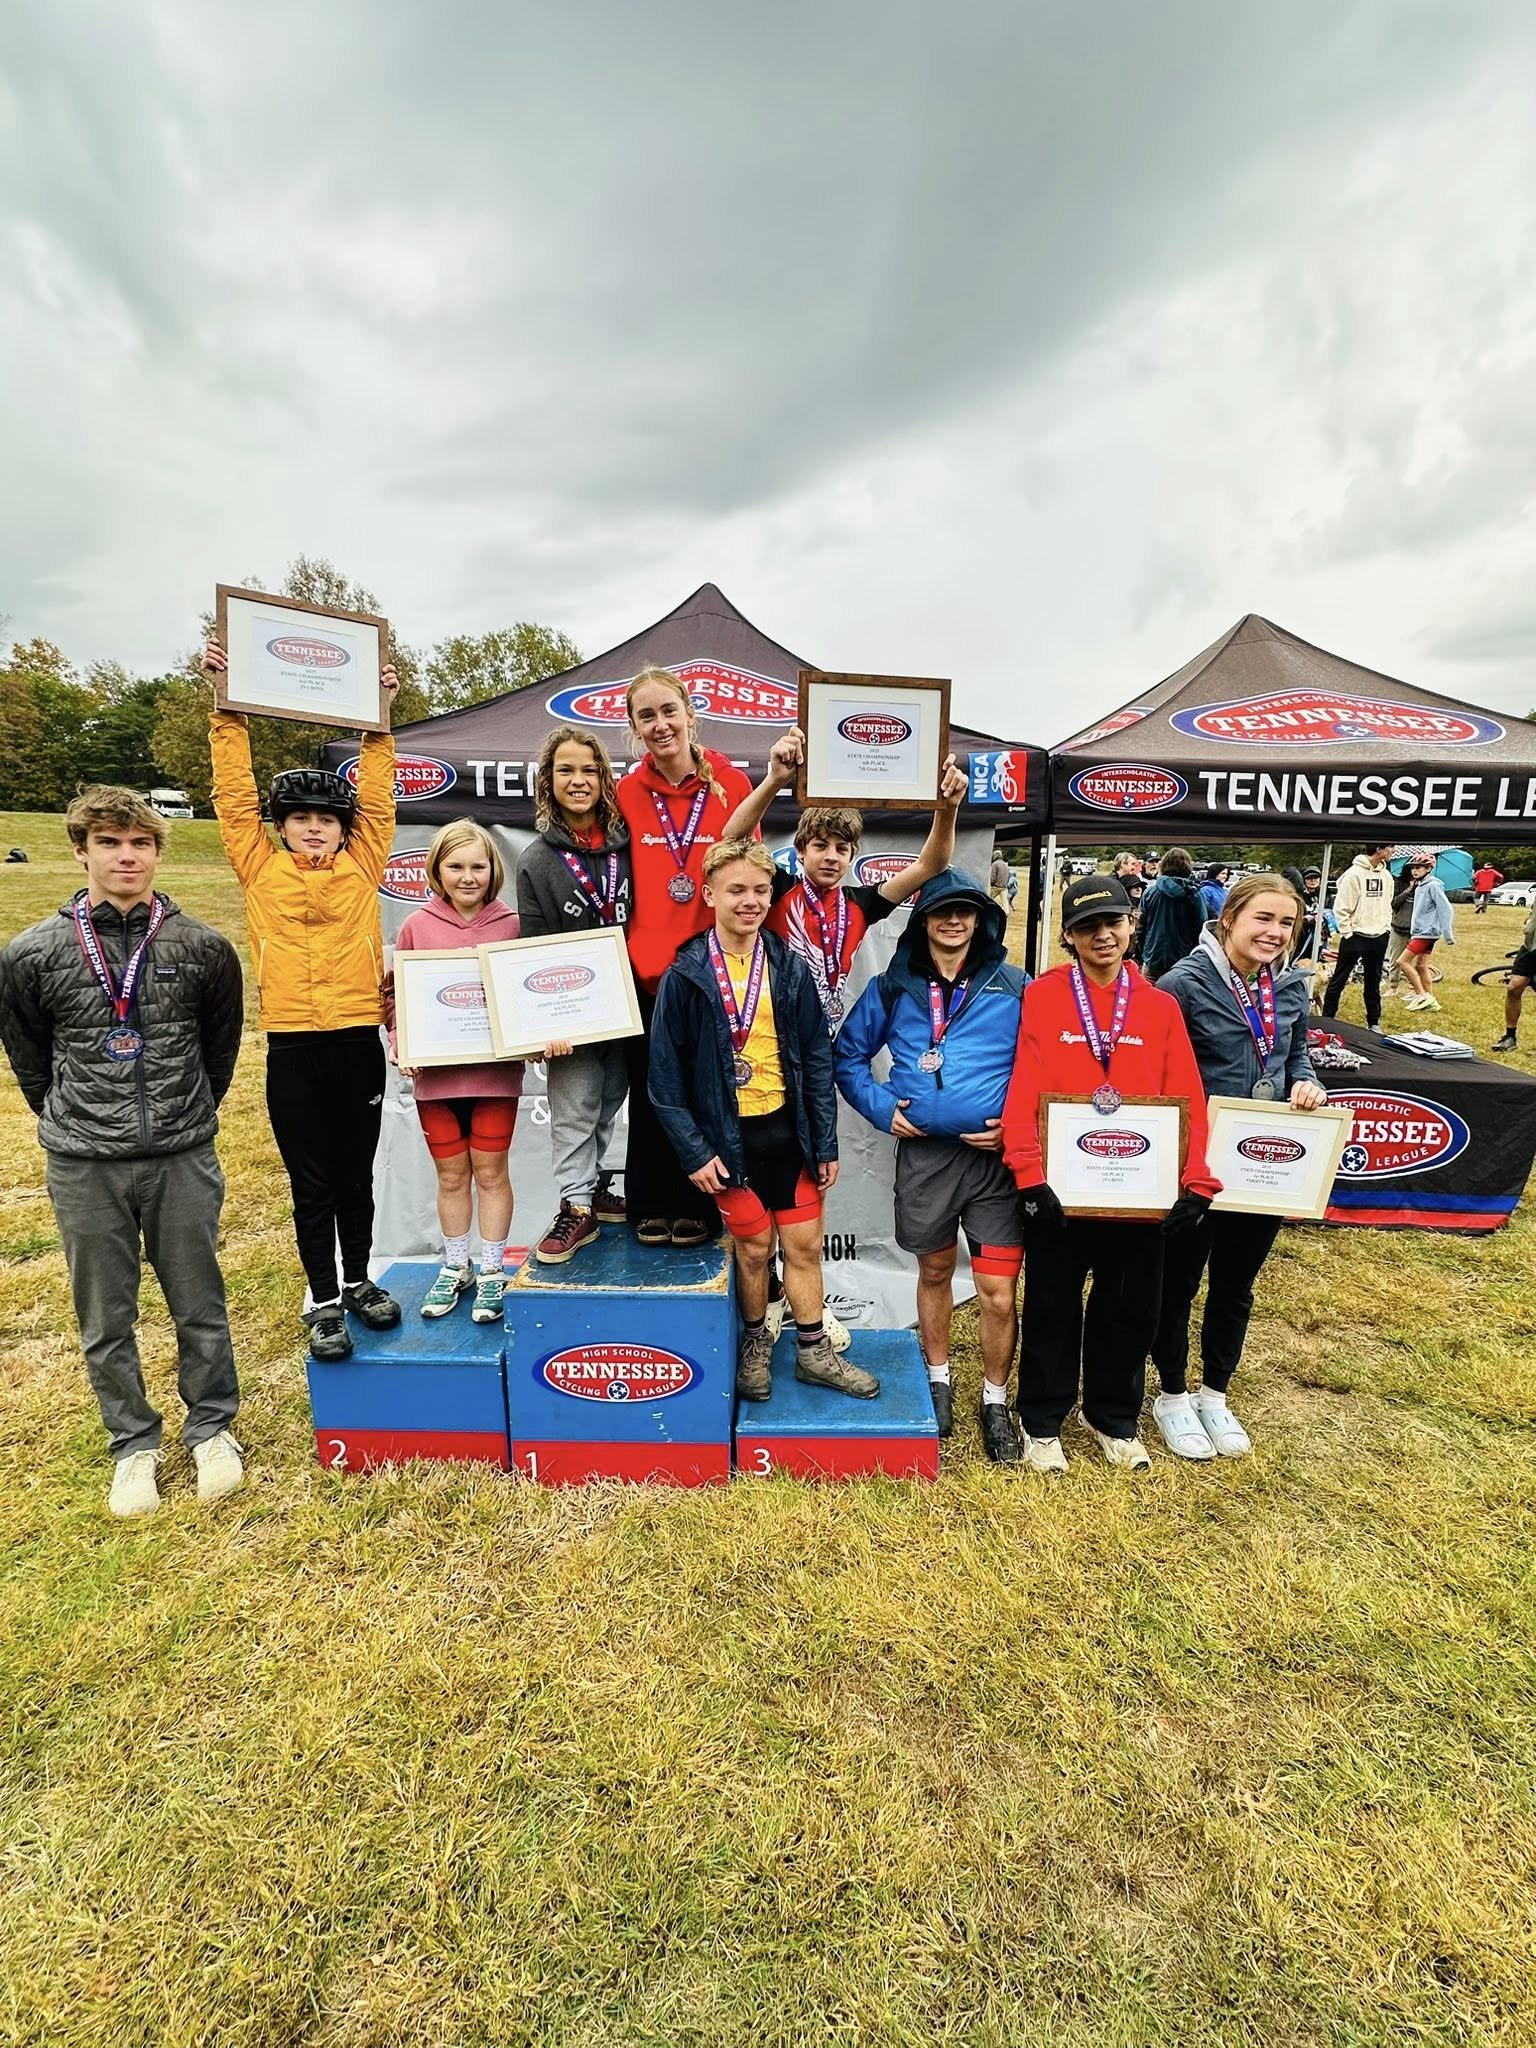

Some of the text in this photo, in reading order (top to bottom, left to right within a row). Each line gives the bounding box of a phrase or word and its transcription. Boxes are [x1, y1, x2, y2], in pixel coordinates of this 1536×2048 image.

[276, 644, 341, 659] TENNESSEE
[674, 665, 762, 688] SCHOLASTIC
[722, 706, 792, 717] LEAGUE
[1246, 695, 1393, 713] INTERSCHOLASTIC
[846, 723, 904, 734] TENNESSEE
[1205, 707, 1462, 732] TENNESSEE
[1232, 731, 1322, 740] CYCLING
[973, 754, 989, 798] NICA
[1101, 769, 1157, 779] INTERSCHOLASTIC
[409, 782, 437, 794] LEAGUE
[1083, 779, 1174, 794] TENNESSEE
[1199, 771, 1482, 817] TENNESSEE
[1088, 792, 1168, 805] CYCLING LEAGUE
[682, 805, 701, 846] TENNESSEE
[608, 854, 618, 903] TENNESSEE
[388, 883, 420, 896] CYCLING
[591, 891, 604, 909] 2025
[79, 918, 101, 975] INCLUSIVITY
[531, 970, 589, 986] TENNESSEE
[742, 985, 758, 1031] TENNESSEE
[728, 1013, 739, 1033] 2025
[1085, 1137, 1142, 1148] TENNESSEE
[1245, 1143, 1299, 1155] TENNESSEE
[1376, 1146, 1429, 1167] LEAGUE
[582, 1348, 654, 1359] HIGH SCHOOL
[551, 1361, 684, 1380] TENNESSEE
[559, 1379, 677, 1397] CYCLING LEAGUE
[328, 1439, 349, 1466] 2
[525, 1451, 538, 1479] 1
[753, 1448, 772, 1476] 3
